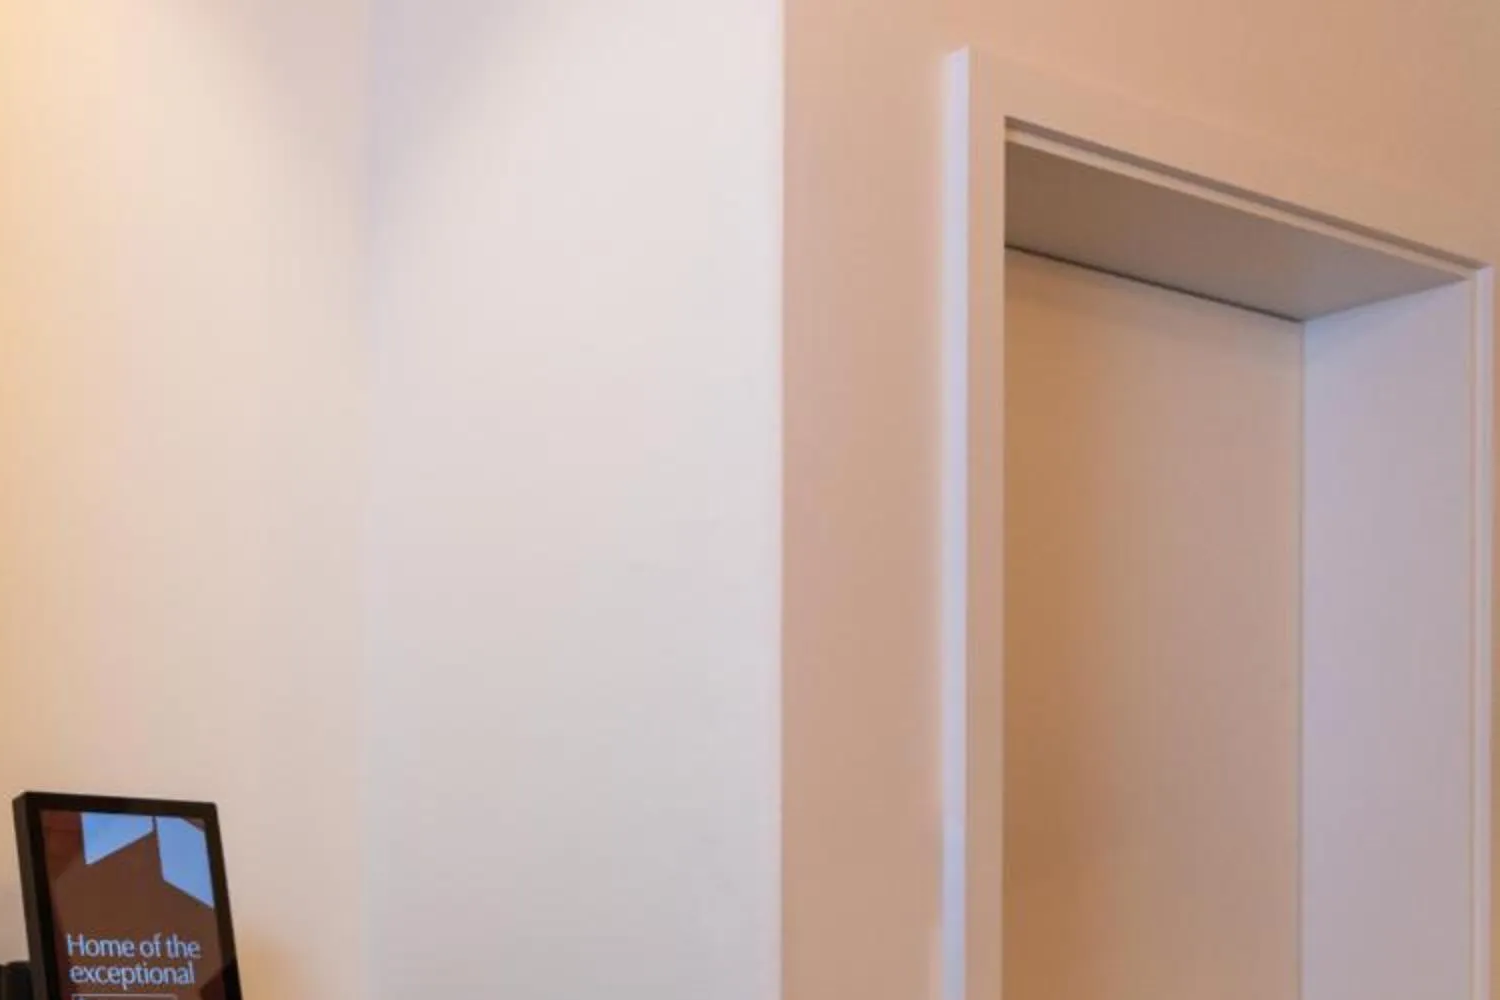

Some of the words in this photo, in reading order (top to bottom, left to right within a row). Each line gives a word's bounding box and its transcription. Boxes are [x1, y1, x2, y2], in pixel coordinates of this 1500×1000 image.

[66, 933, 135, 957] Home
[140, 932, 162, 958] of
[166, 932, 202, 958] the
[69, 961, 195, 990] exceptional
